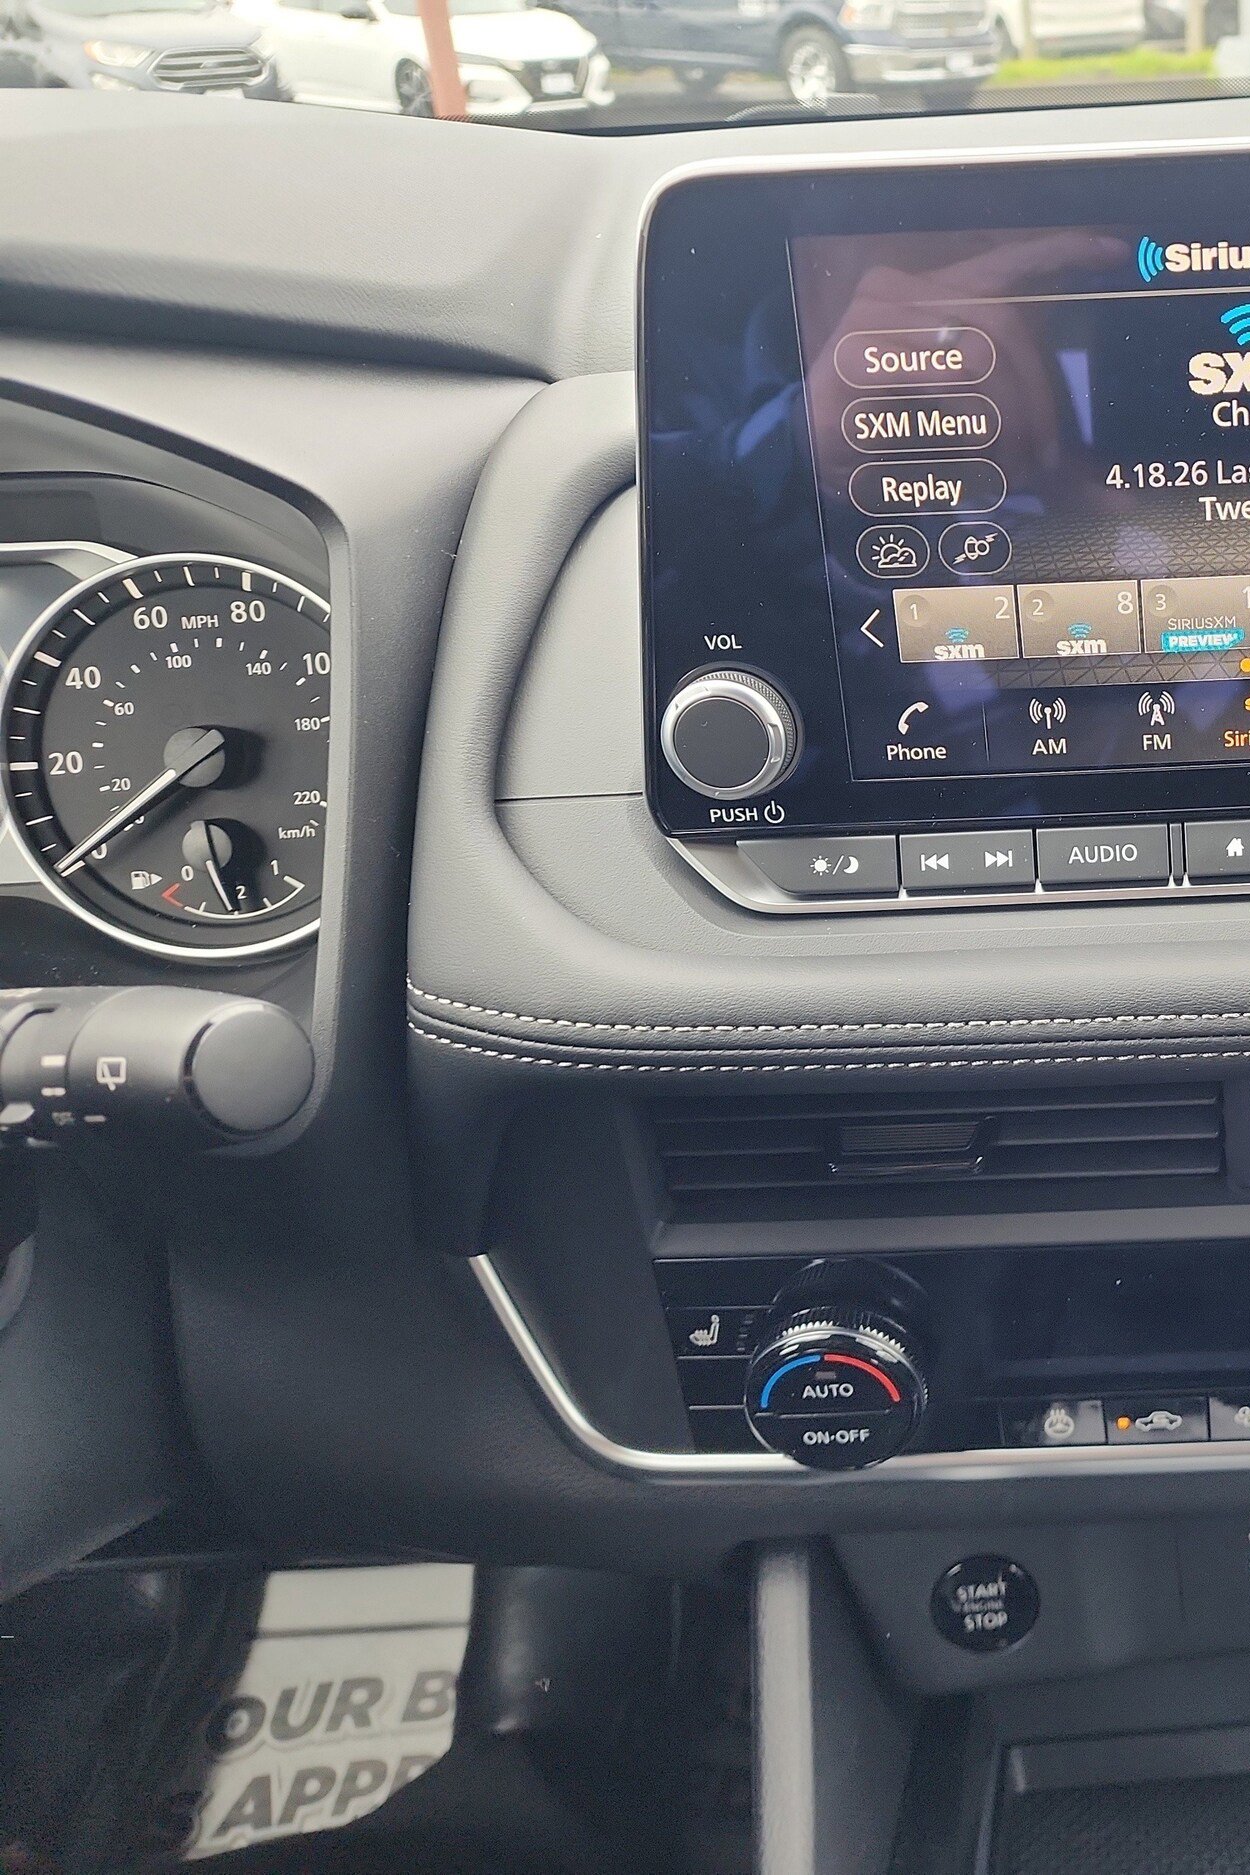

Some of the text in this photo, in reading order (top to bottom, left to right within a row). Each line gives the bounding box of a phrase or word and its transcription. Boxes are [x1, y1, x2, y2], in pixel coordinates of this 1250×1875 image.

[863, 345, 963, 374] Source
[855, 410, 987, 440] SXM Menu
[1105, 460, 1208, 489] 4.18.26
[881, 474, 962, 507] Replay
[994, 595, 1010, 619] 2
[1031, 598, 1045, 616] 2
[1116, 591, 1134, 614] 8
[1155, 593, 1167, 611] 3
[133, 604, 168, 630] 60
[229, 599, 266, 625] 80
[910, 603, 919, 620] 1
[181, 614, 219, 630] MPH
[1167, 615, 1237, 631] SIRIUSXM
[704, 634, 742, 650] VOL
[1056, 639, 1107, 656] sxm
[1168, 633, 1238, 648] PREVIEW
[934, 643, 985, 660] sxm
[165, 654, 192, 671] 100
[246, 662, 272, 677] 140
[65, 665, 101, 690] 40
[114, 701, 135, 716] 60
[294, 716, 321, 732] 180
[1032, 738, 1067, 755] AM
[1142, 733, 1172, 751] FM
[886, 744, 947, 761] Phone
[48, 750, 84, 775] 20
[111, 777, 131, 792] 20
[293, 790, 321, 806] 220
[709, 807, 758, 823] PUSH
[278, 825, 316, 839] km/h
[1068, 843, 1138, 865] AUDIO
[181, 866, 194, 881] 0
[270, 859, 279, 875] 1
[802, 1383, 854, 1399] AUTO
[955, 1581, 1006, 1603] START
[964, 1610, 1008, 1633] STOP
